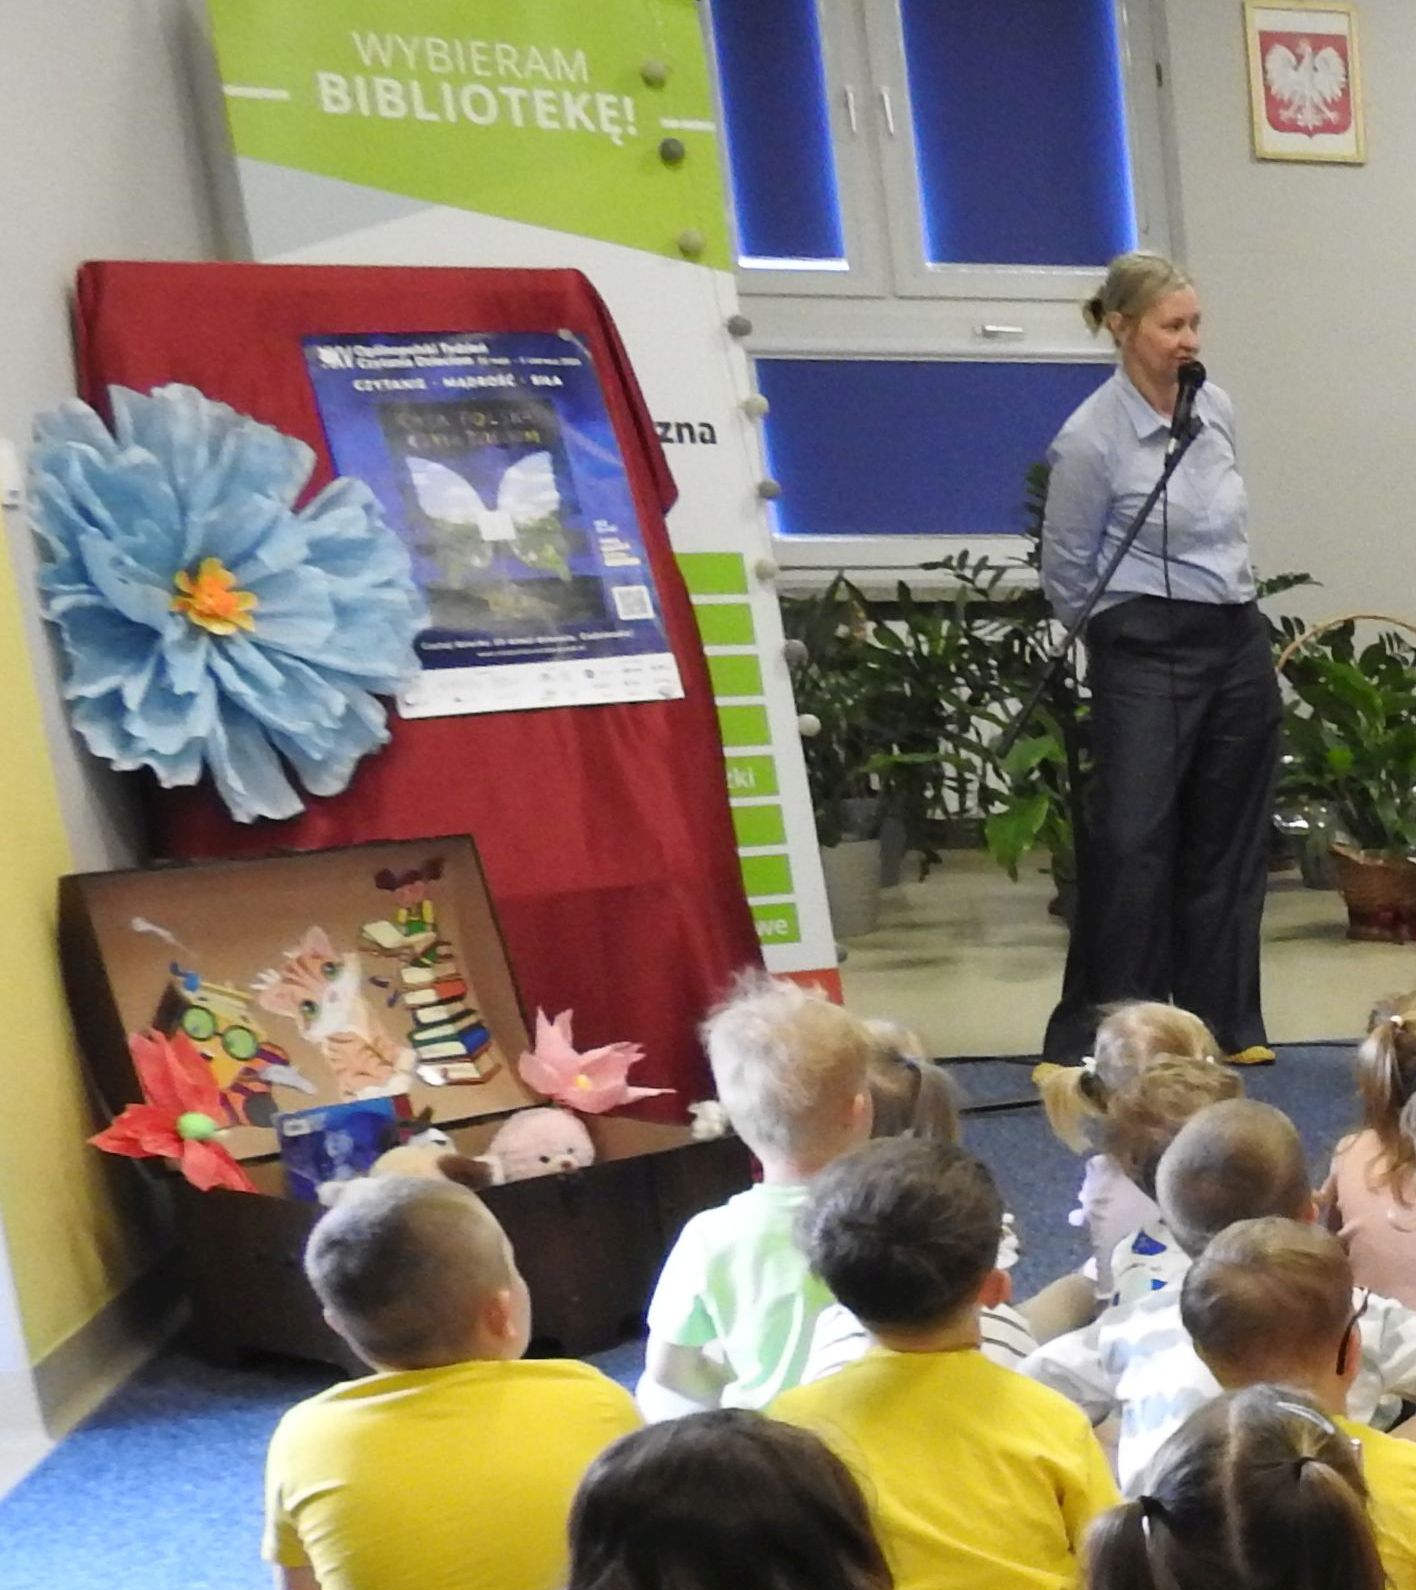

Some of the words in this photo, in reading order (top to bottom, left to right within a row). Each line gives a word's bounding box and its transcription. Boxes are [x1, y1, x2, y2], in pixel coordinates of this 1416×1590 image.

[351, 30, 589, 84] WYBIERAM
[316, 69, 638, 147] BIBLIOTEKĘ!
[352, 378, 428, 391] CZYTANIE
